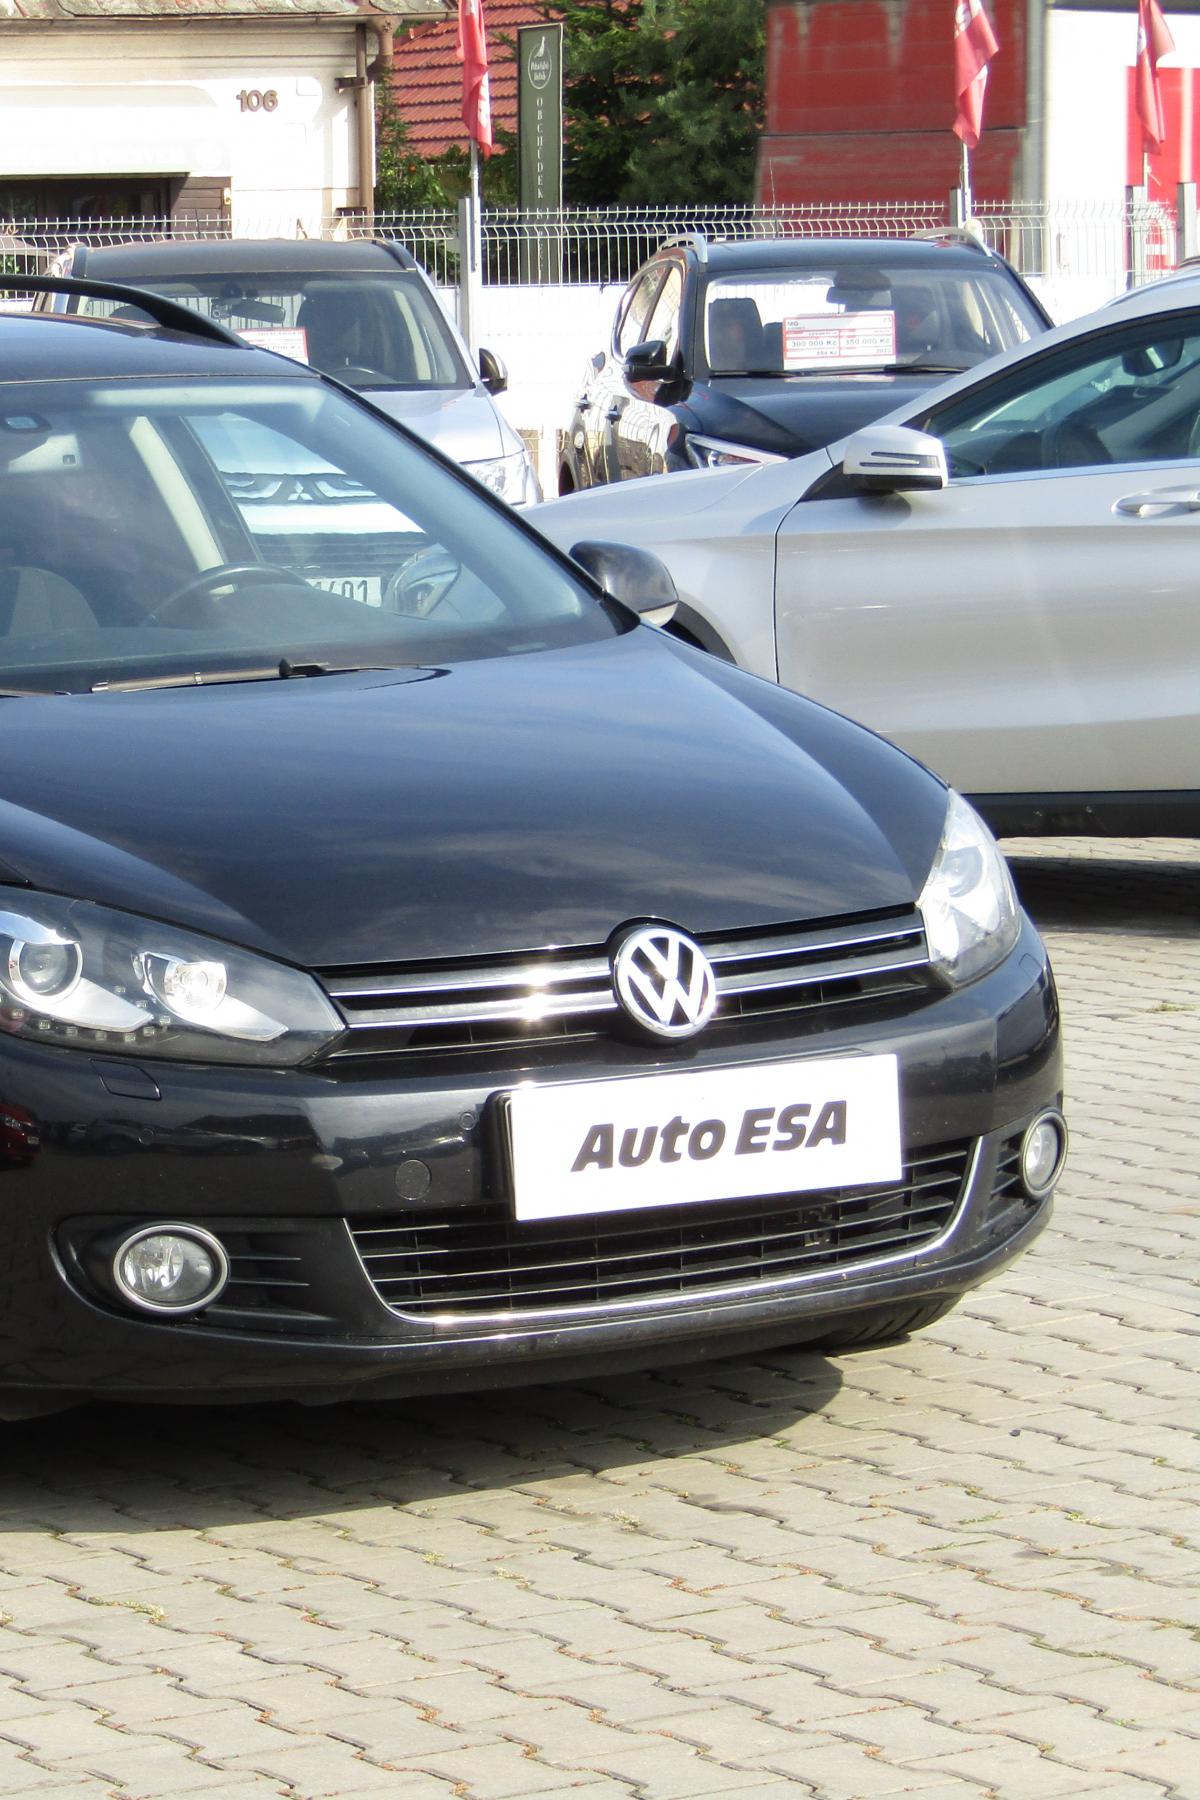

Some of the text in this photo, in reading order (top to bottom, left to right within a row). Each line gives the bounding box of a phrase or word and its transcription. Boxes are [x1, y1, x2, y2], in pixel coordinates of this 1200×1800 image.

[235, 89, 279, 113] 106
[570, 1100, 847, 1172] Auto ESA
